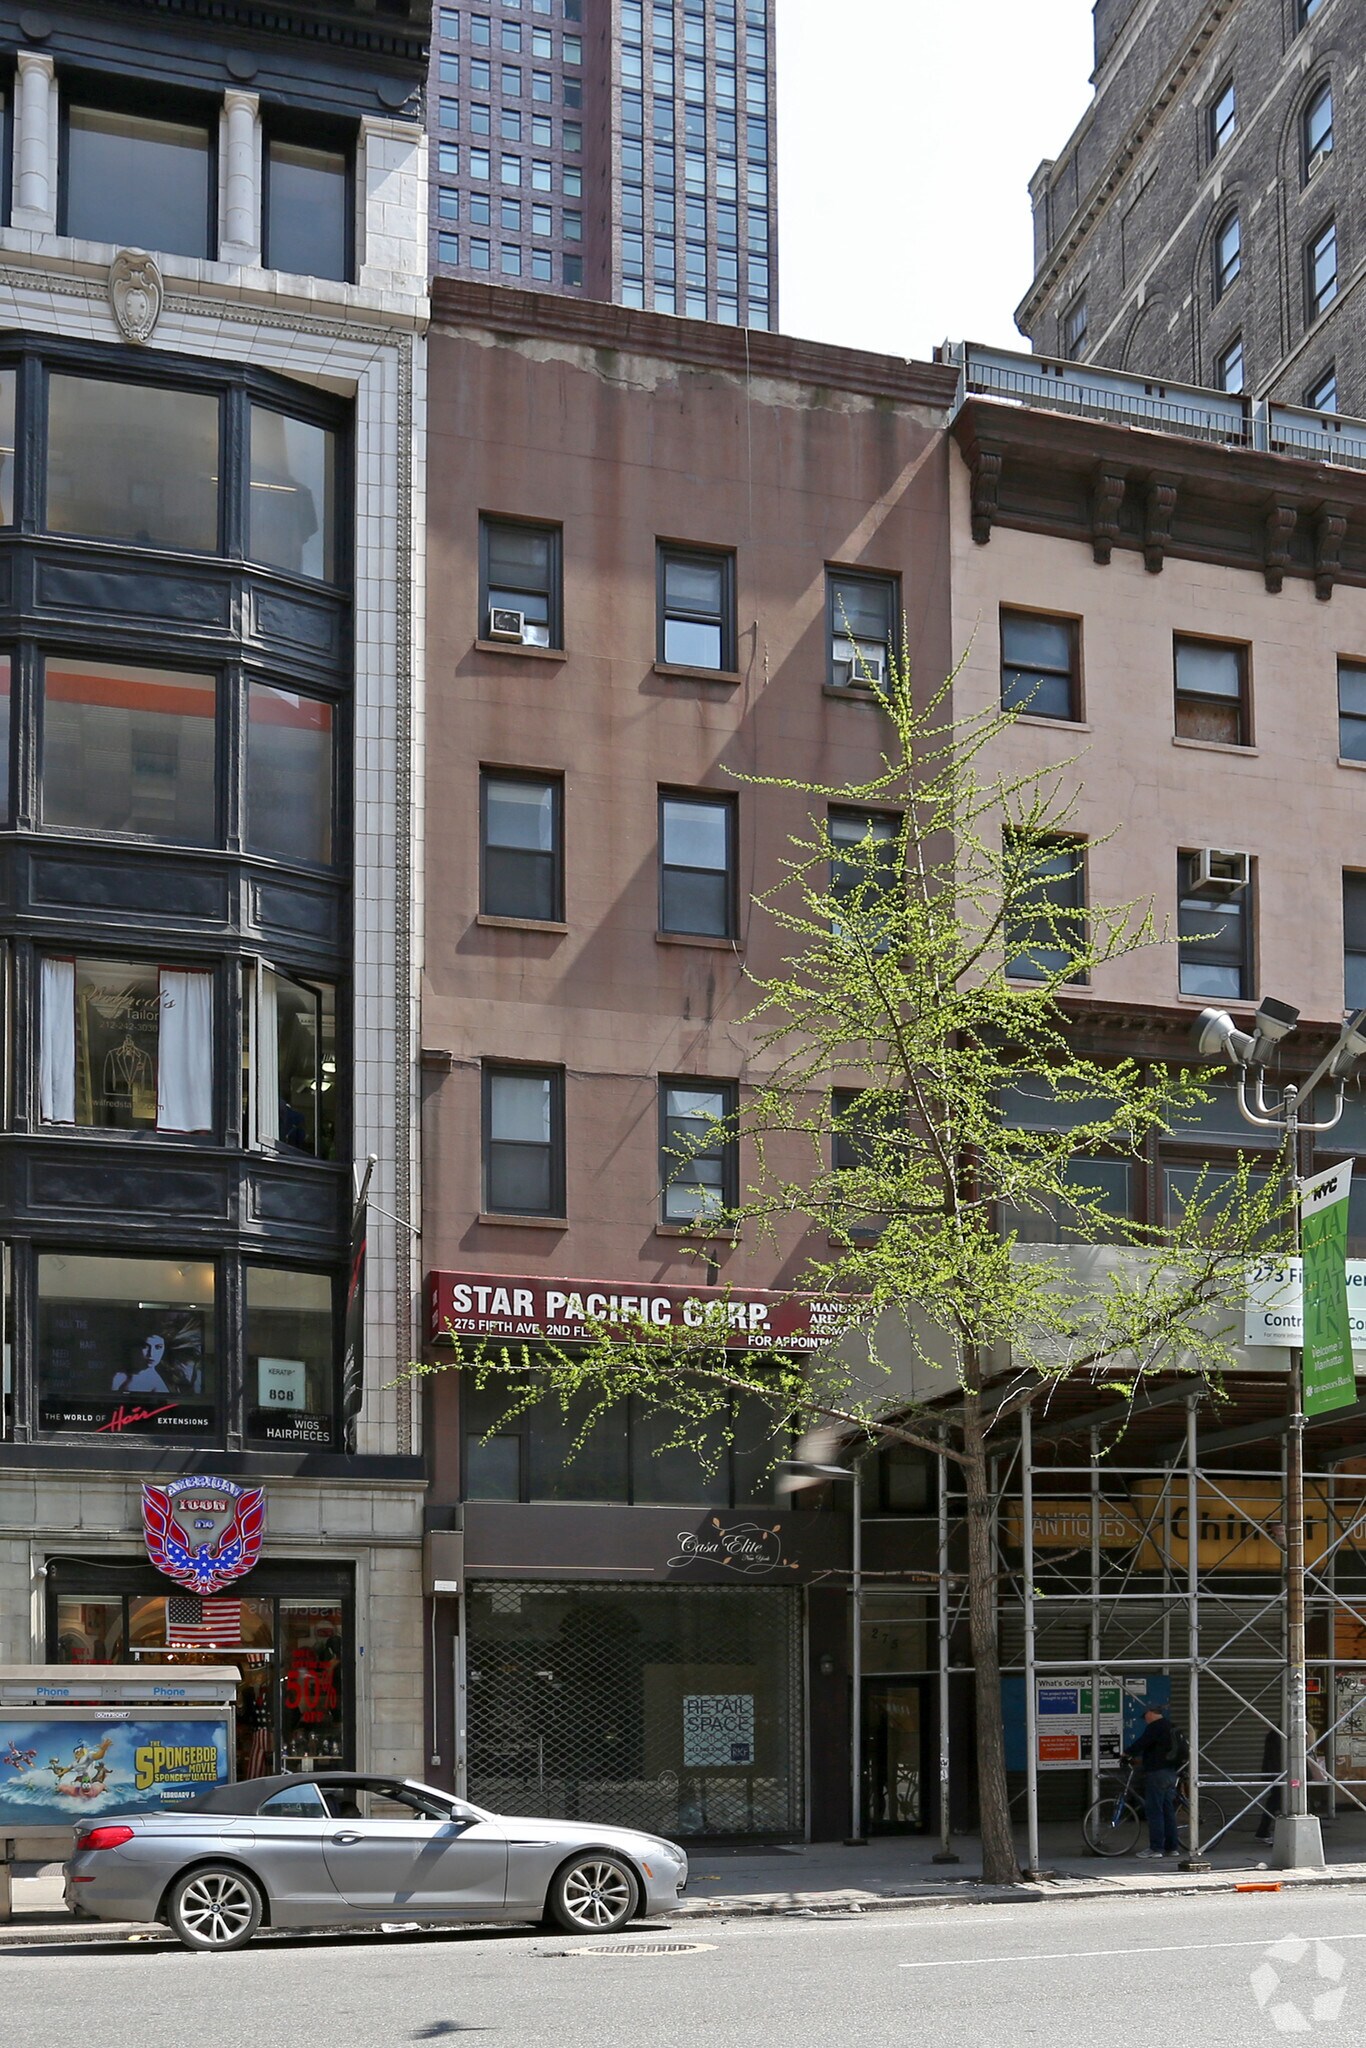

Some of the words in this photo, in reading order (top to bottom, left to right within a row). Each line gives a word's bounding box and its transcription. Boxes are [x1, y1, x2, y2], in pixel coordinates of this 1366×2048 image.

[127, 1008, 159, 1021] Tailor
[1313, 1177, 1338, 1201] NYC
[452, 1283, 534, 1318] STAR
[546, 1290, 672, 1327] PACIFIC
[683, 1297, 772, 1331] CORP.
[454, 1318, 475, 1330] 275
[478, 1319, 513, 1333] FIFTH
[546, 1324, 571, 1337] 2ND
[573, 1325, 592, 1338] FL.
[748, 1335, 772, 1347] FOR
[1314, 1355, 1345, 1371] Manhattan
[45, 1413, 61, 1421] THE
[63, 1414, 93, 1422] WORLD
[95, 1403, 179, 1433] Hair
[157, 1417, 209, 1426] EXTENSIONS
[294, 1420, 320, 1430] WIGS
[266, 1428, 330, 1442] HAIRPIECES
[167, 1475, 245, 1498] AMERICAN
[178, 1499, 228, 1513] ICON
[1032, 1511, 1127, 1538] ANTIQUES
[677, 1531, 719, 1553] Casa
[721, 1534, 763, 1556] Elite
[741, 1553, 755, 1561] New
[754, 1553, 770, 1563] York
[871, 1627, 899, 1650] 275
[36, 1687, 70, 1696] Phone
[153, 1687, 186, 1696] Phone
[285, 1669, 337, 1709] 50%
[1038, 1679, 1063, 1687] What's
[1064, 1679, 1086, 1688] Going
[687, 1699, 748, 1715] RETAIL
[687, 1716, 748, 1732] SPACE
[136, 1746, 217, 1790] SPONGEBOB
[189, 1762, 217, 1773] MOVIE
[154, 1773, 184, 1782] SPONGE
[191, 1773, 218, 1781] WATER
[160, 1791, 189, 1799] FEBRUARY
